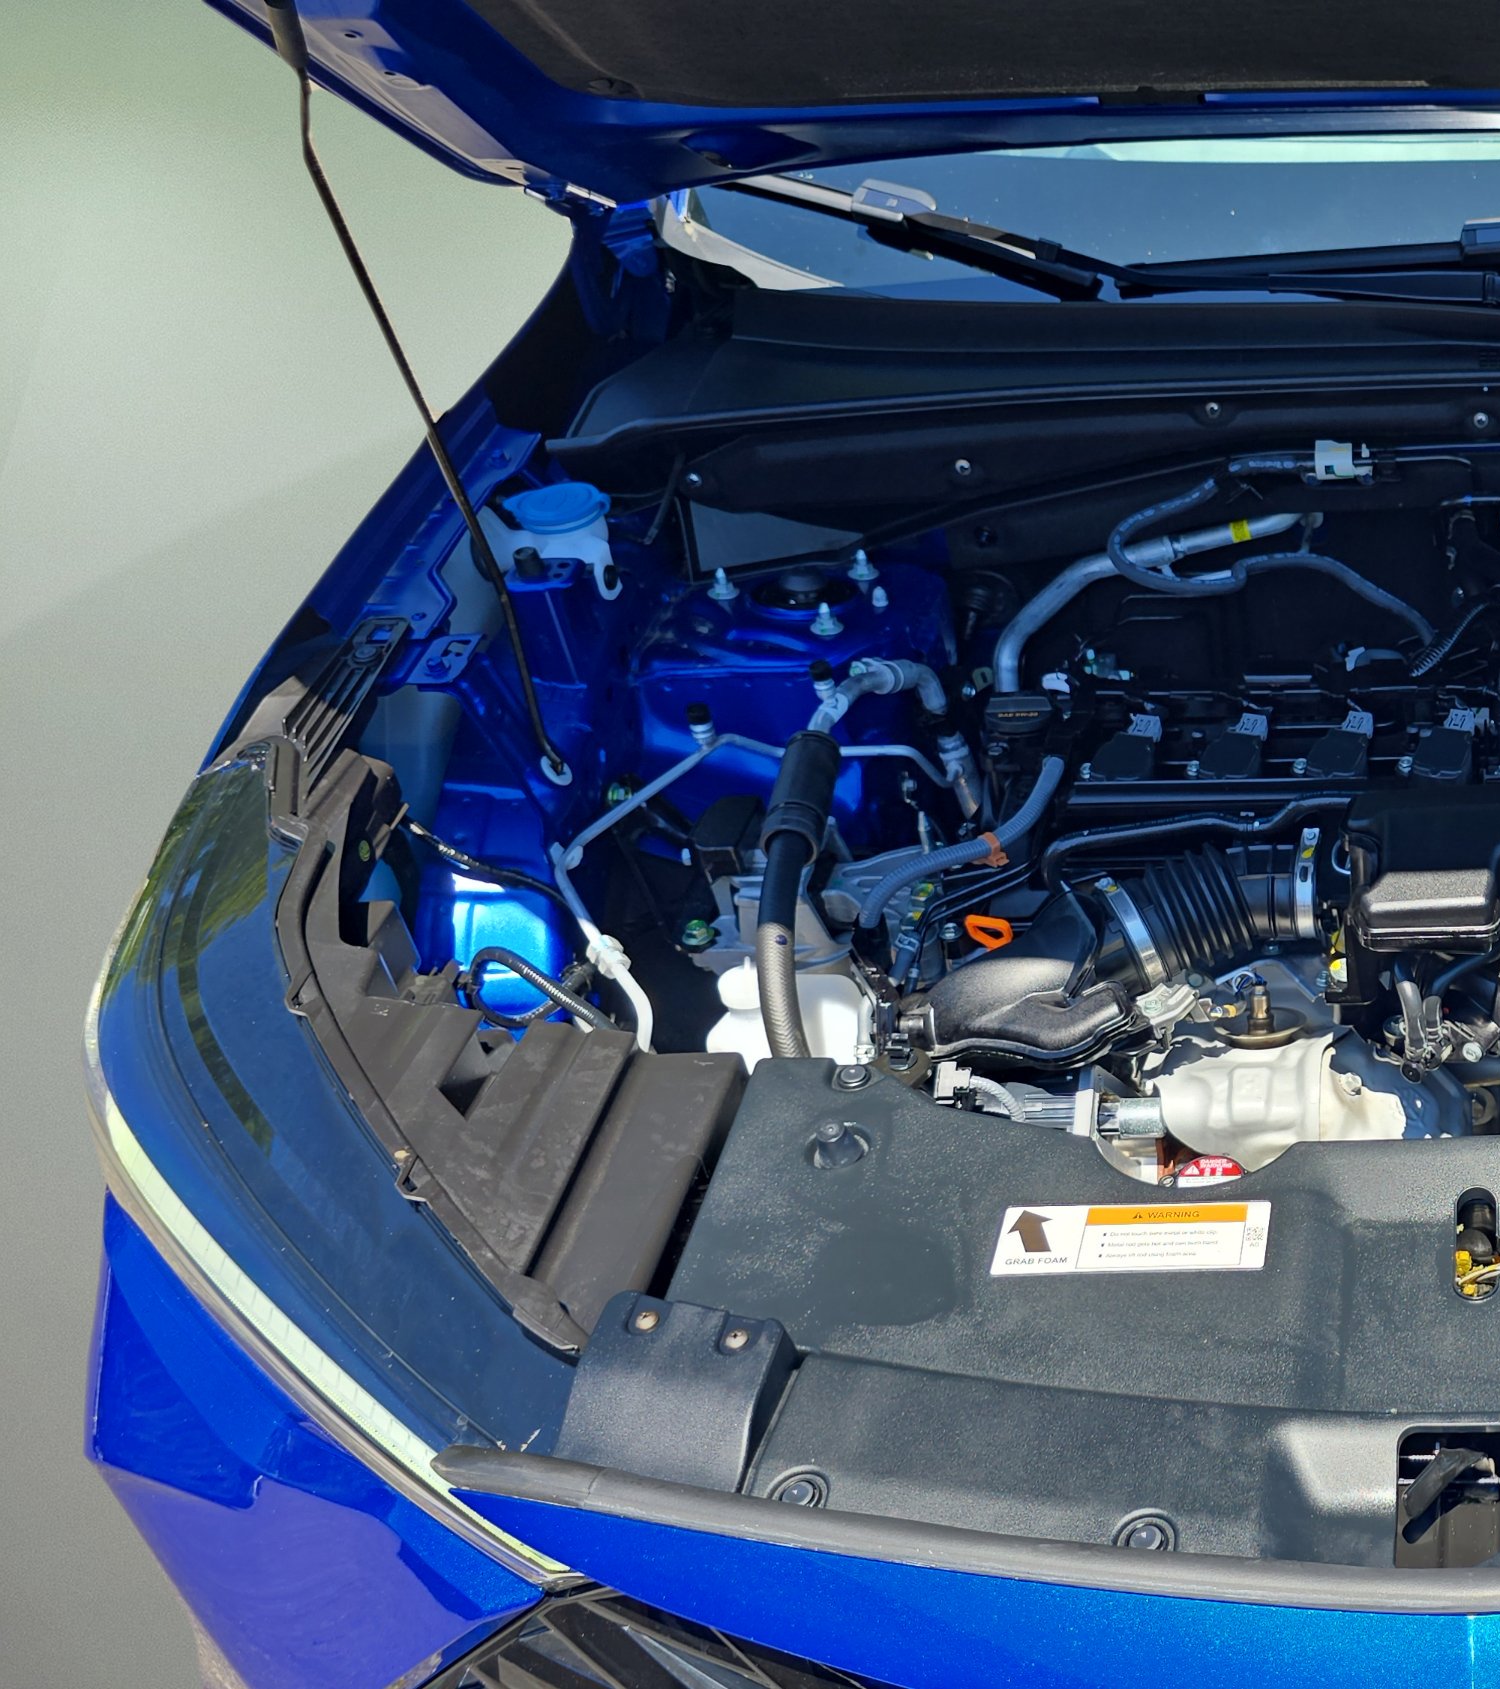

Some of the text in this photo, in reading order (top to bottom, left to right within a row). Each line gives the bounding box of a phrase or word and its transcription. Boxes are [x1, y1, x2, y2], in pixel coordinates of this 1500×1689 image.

[1147, 1210, 1200, 1219] WARNING
[1004, 1256, 1067, 1266] GRAB FOAM
